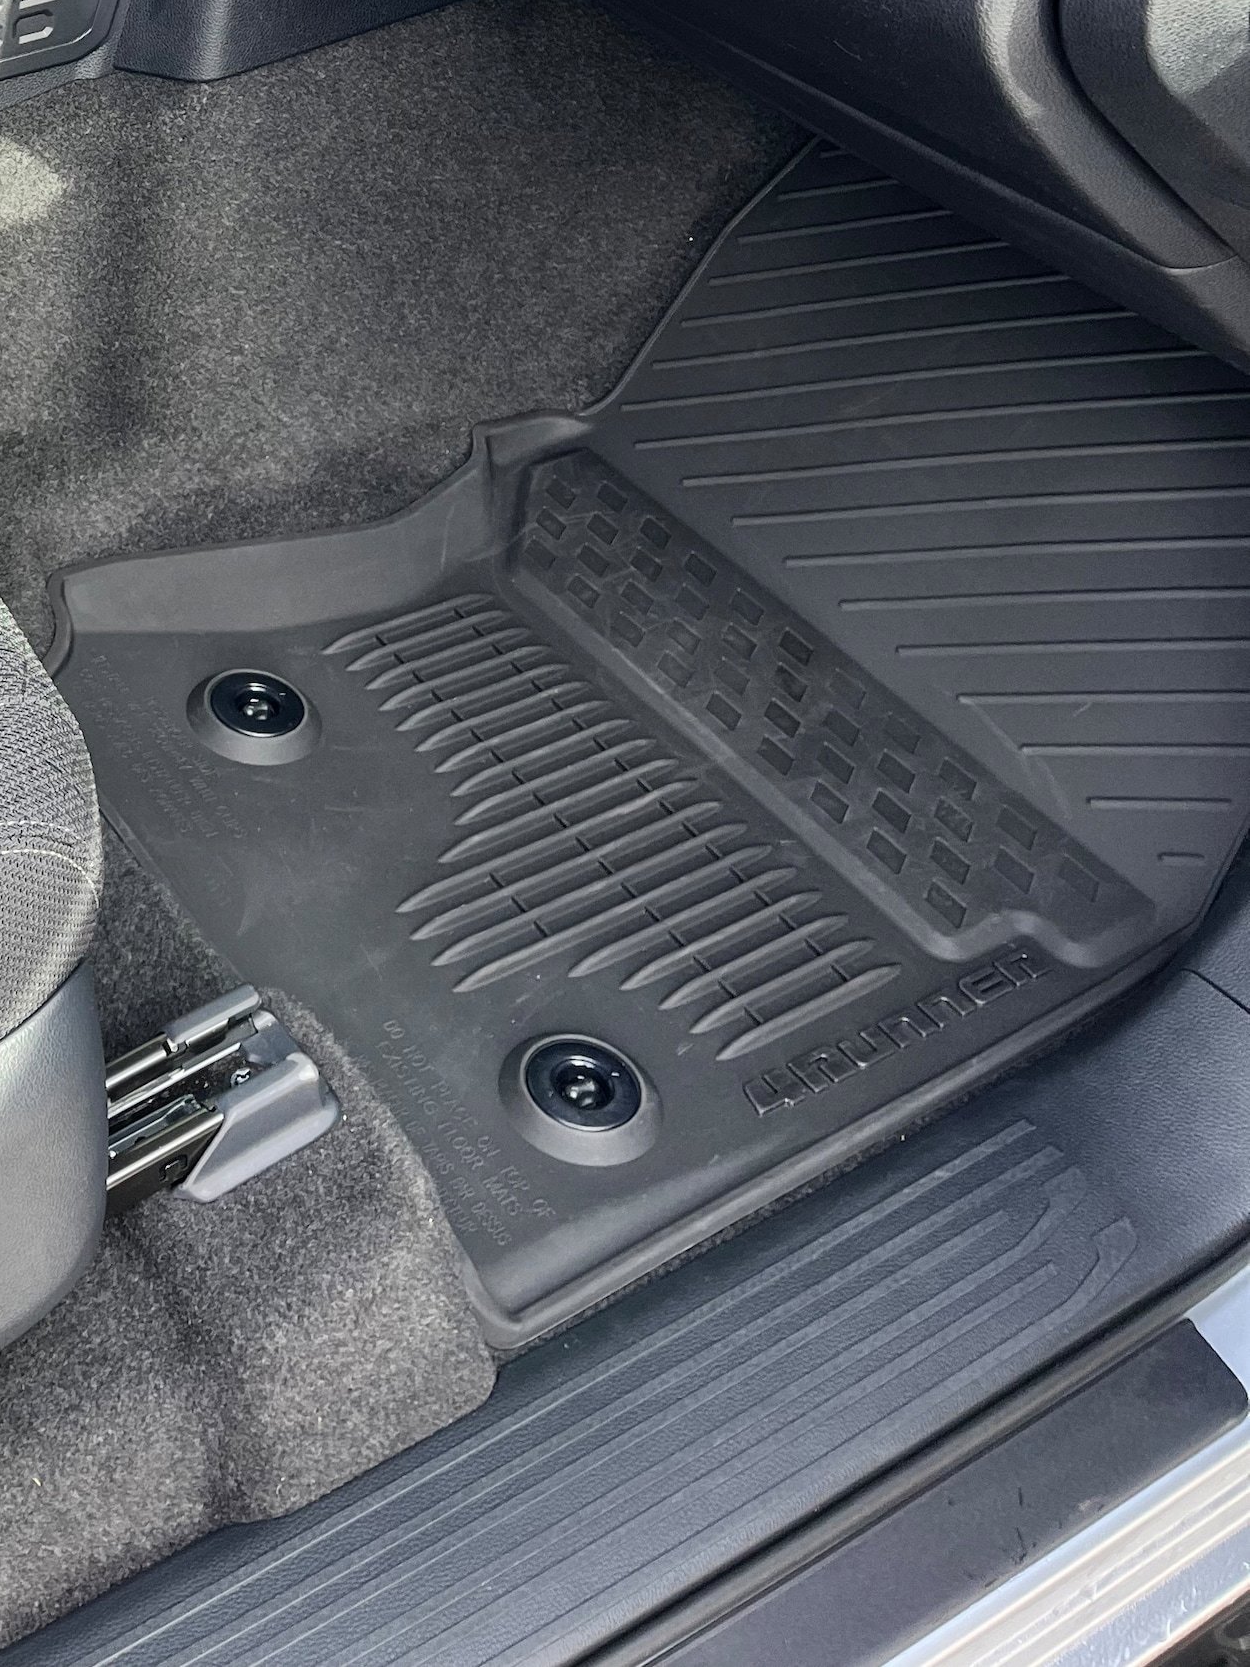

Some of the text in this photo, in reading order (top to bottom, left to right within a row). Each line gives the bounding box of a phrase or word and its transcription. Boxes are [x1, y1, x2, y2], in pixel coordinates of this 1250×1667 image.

[377, 1041, 438, 1116] EXISTING
[483, 1175, 522, 1217] MATS
[403, 1045, 434, 1074] NOT
[431, 1080, 479, 1131] PLACE
[501, 1165, 529, 1192] TOP
